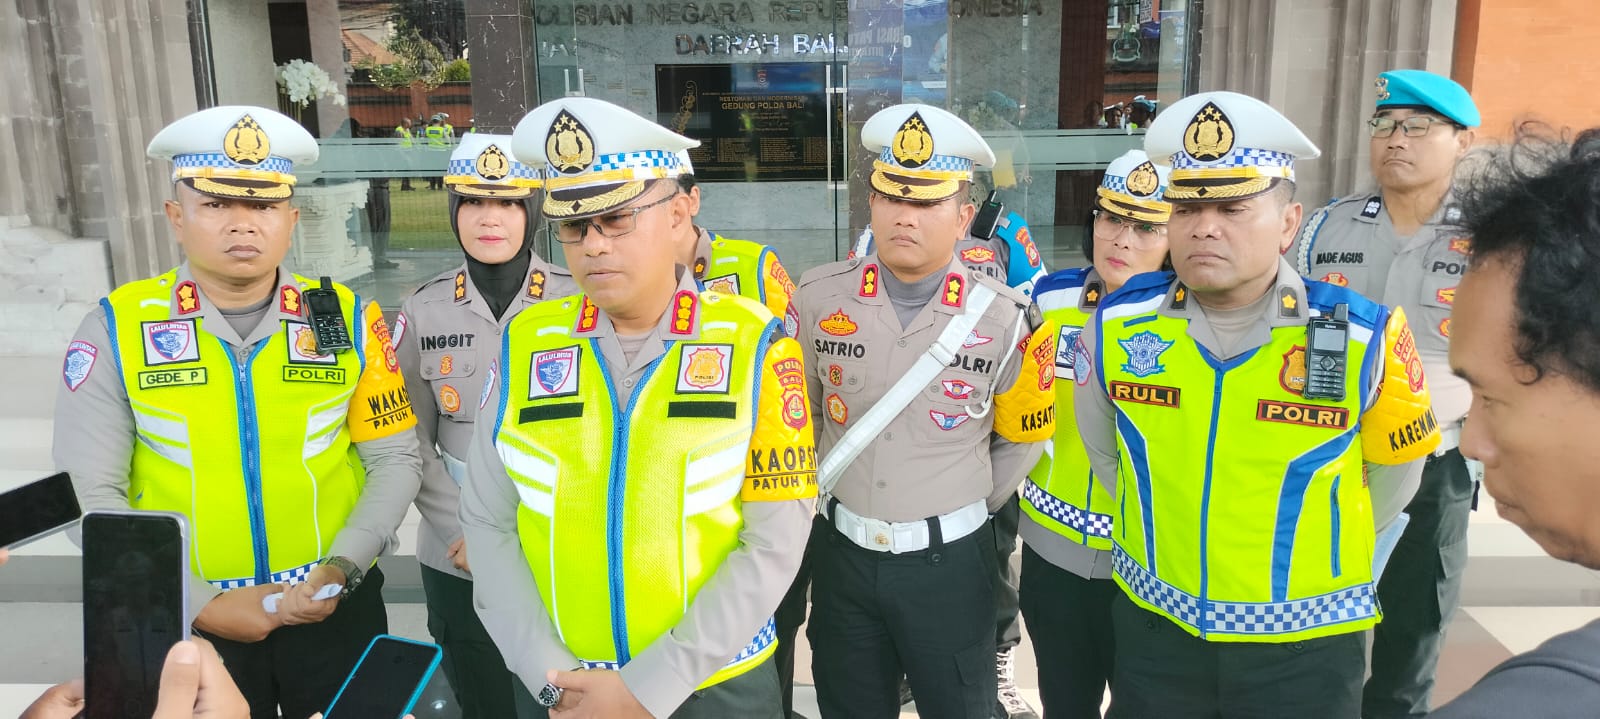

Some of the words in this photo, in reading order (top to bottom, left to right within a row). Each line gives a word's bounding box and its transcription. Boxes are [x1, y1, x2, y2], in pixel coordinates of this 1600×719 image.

[647, 3, 755, 25] NEGARA
[675, 33, 779, 55] DAERAH
[786, 101, 805, 109] BALI
[1338, 252, 1364, 264] AGUS
[421, 334, 475, 350] INGGIT
[815, 338, 865, 359] SATRIO
[190, 371, 198, 382] P
[288, 369, 341, 380] POLRI
[1115, 385, 1173, 404] RULI
[373, 409, 409, 430] PATUH
[1266, 404, 1342, 426] POLRI
[753, 475, 799, 491] PATUH
